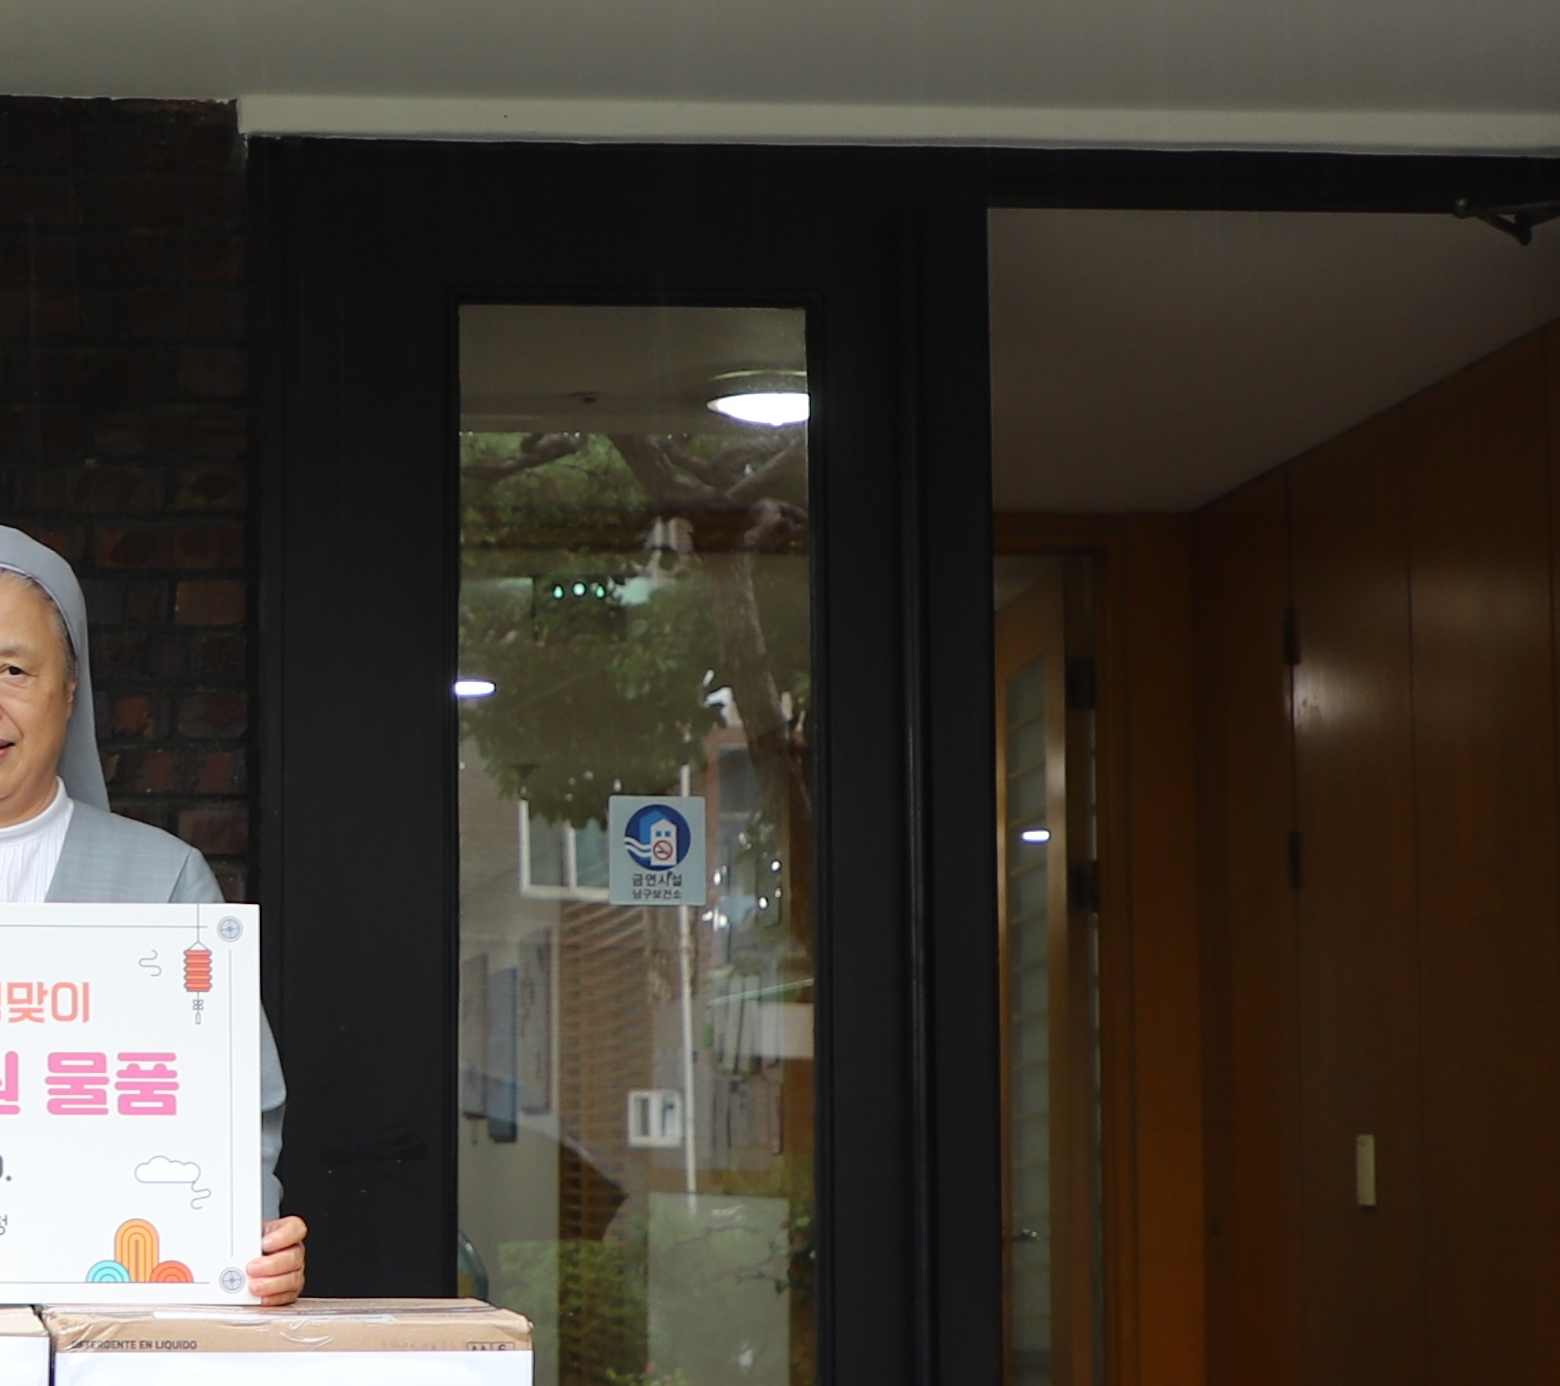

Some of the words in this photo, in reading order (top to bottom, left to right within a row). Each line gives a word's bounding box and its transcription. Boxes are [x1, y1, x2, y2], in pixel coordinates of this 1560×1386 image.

[632, 871, 682, 887] 금연시설
[632, 889, 682, 899] 남구보건소
[45, 1052, 179, 1116] 물품
[139, 1340, 152, 1350] EN
[155, 1340, 198, 1350] LIQUIDO
